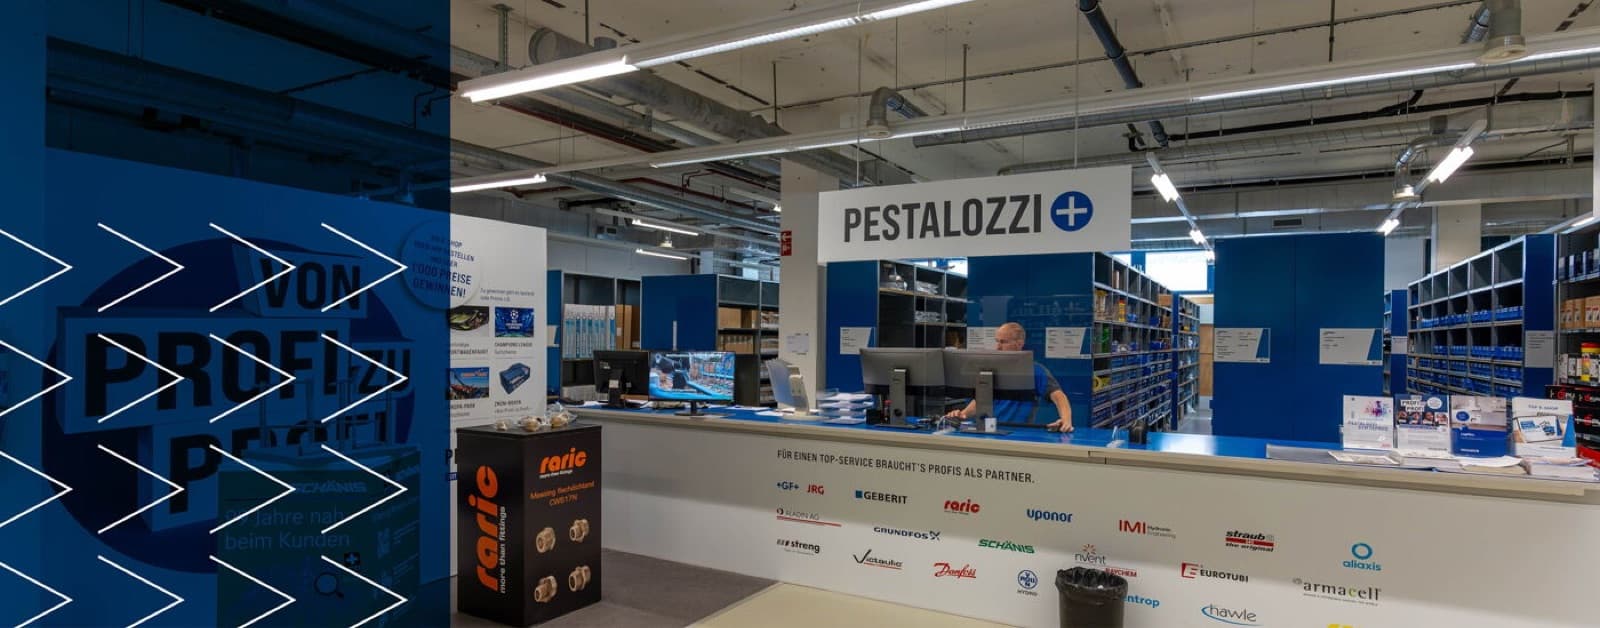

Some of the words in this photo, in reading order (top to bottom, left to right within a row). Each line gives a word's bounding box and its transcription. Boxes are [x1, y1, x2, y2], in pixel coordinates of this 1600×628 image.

[843, 194, 1042, 243] PESTALOZZI
[259, 257, 362, 310] VON
[440, 268, 472, 285] PREISE
[84, 330, 340, 418] PROFI
[358, 348, 412, 393] ZU
[539, 446, 588, 475] raric
[777, 449, 793, 460] FÜR
[793, 451, 818, 462] EINEN
[819, 454, 874, 468] TOP-SERVICE
[875, 459, 926, 474] BRAUCHT'S
[928, 463, 962, 477] PROFIS
[964, 467, 983, 479] ALS
[985, 469, 1036, 484] PARTNER.
[807, 484, 825, 496] JRG
[863, 491, 908, 505] GEBERIT
[943, 499, 981, 514] raric
[255, 507, 304, 528] Jahre
[310, 504, 346, 525] nah
[1026, 508, 1074, 526] uponor
[468, 465, 499, 592] raric
[873, 526, 929, 540] GRUNDFOS
[1119, 519, 1146, 534] IMI
[225, 532, 273, 551] beim
[279, 531, 351, 548] Kunden
[1225, 530, 1266, 541] straub
[790, 540, 821, 554] streng
[978, 539, 1036, 554] SCHÄNIS
[1342, 560, 1382, 571] aliaxis
[1199, 568, 1249, 583] EUROTUBI
[1303, 582, 1380, 601] armacell
[1125, 594, 1161, 609] ntrop
[1209, 603, 1258, 623] hawle
